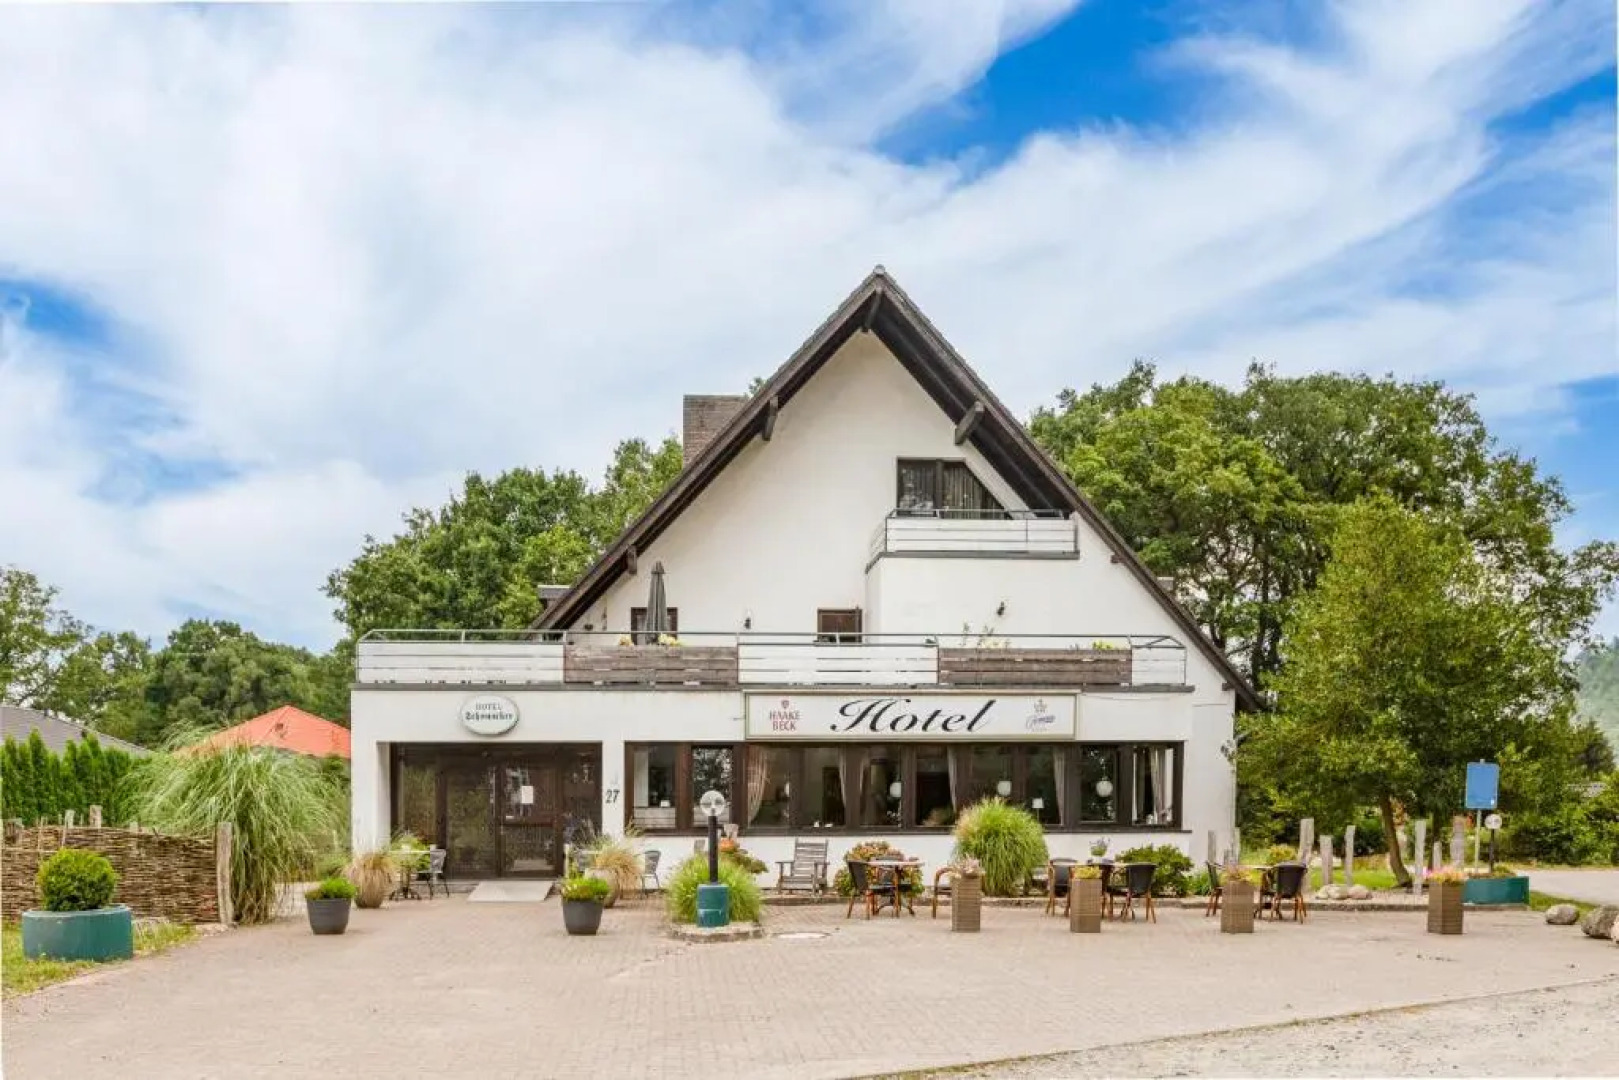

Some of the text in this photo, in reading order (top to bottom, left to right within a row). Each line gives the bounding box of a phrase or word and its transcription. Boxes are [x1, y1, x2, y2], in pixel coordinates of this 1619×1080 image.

[475, 702, 502, 710] HOTEL
[769, 710, 803, 720] HAAKE
[830, 698, 997, 732] Hotel
[772, 720, 796, 731] BECK
[605, 789, 620, 804] 27
